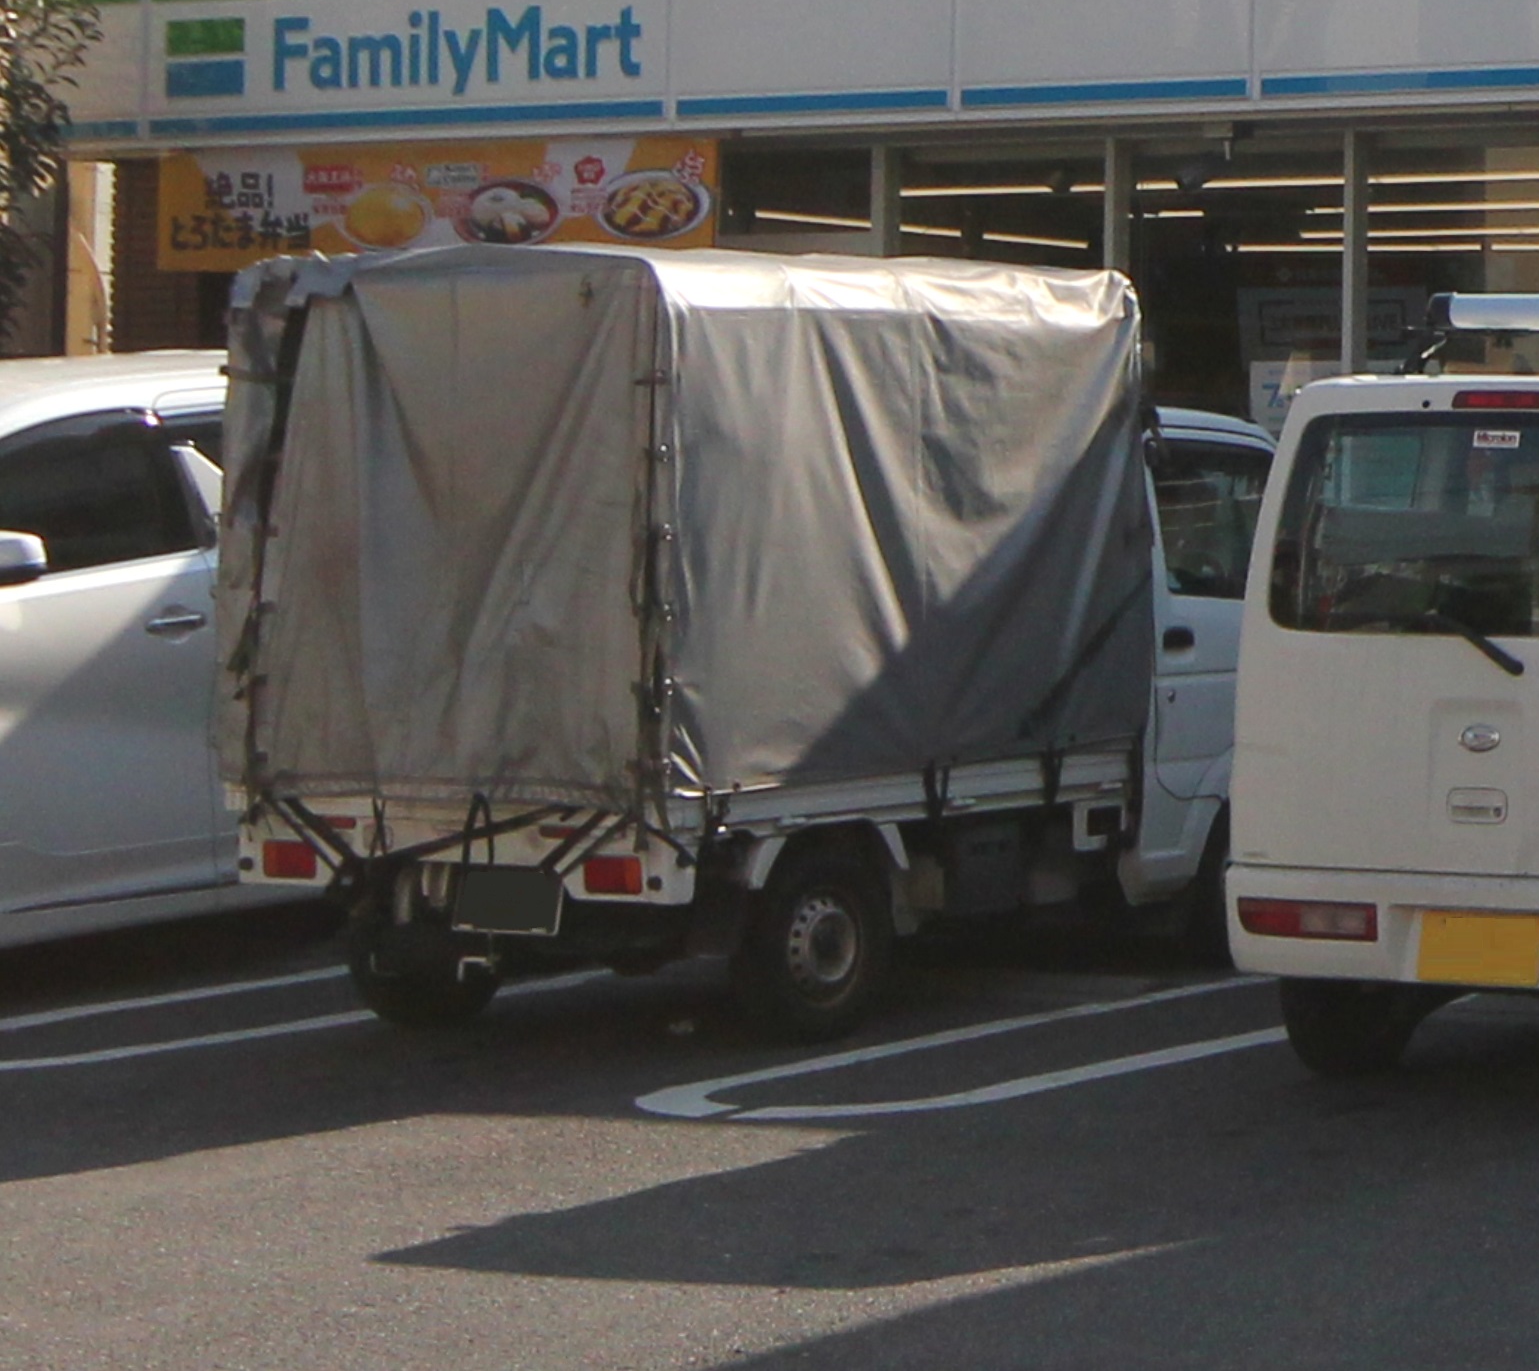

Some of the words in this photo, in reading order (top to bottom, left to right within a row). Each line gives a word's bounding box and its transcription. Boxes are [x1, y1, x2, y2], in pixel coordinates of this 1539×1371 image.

[272, 4, 642, 96] FamilyMart
[170, 210, 312, 251] とろたま弁当
